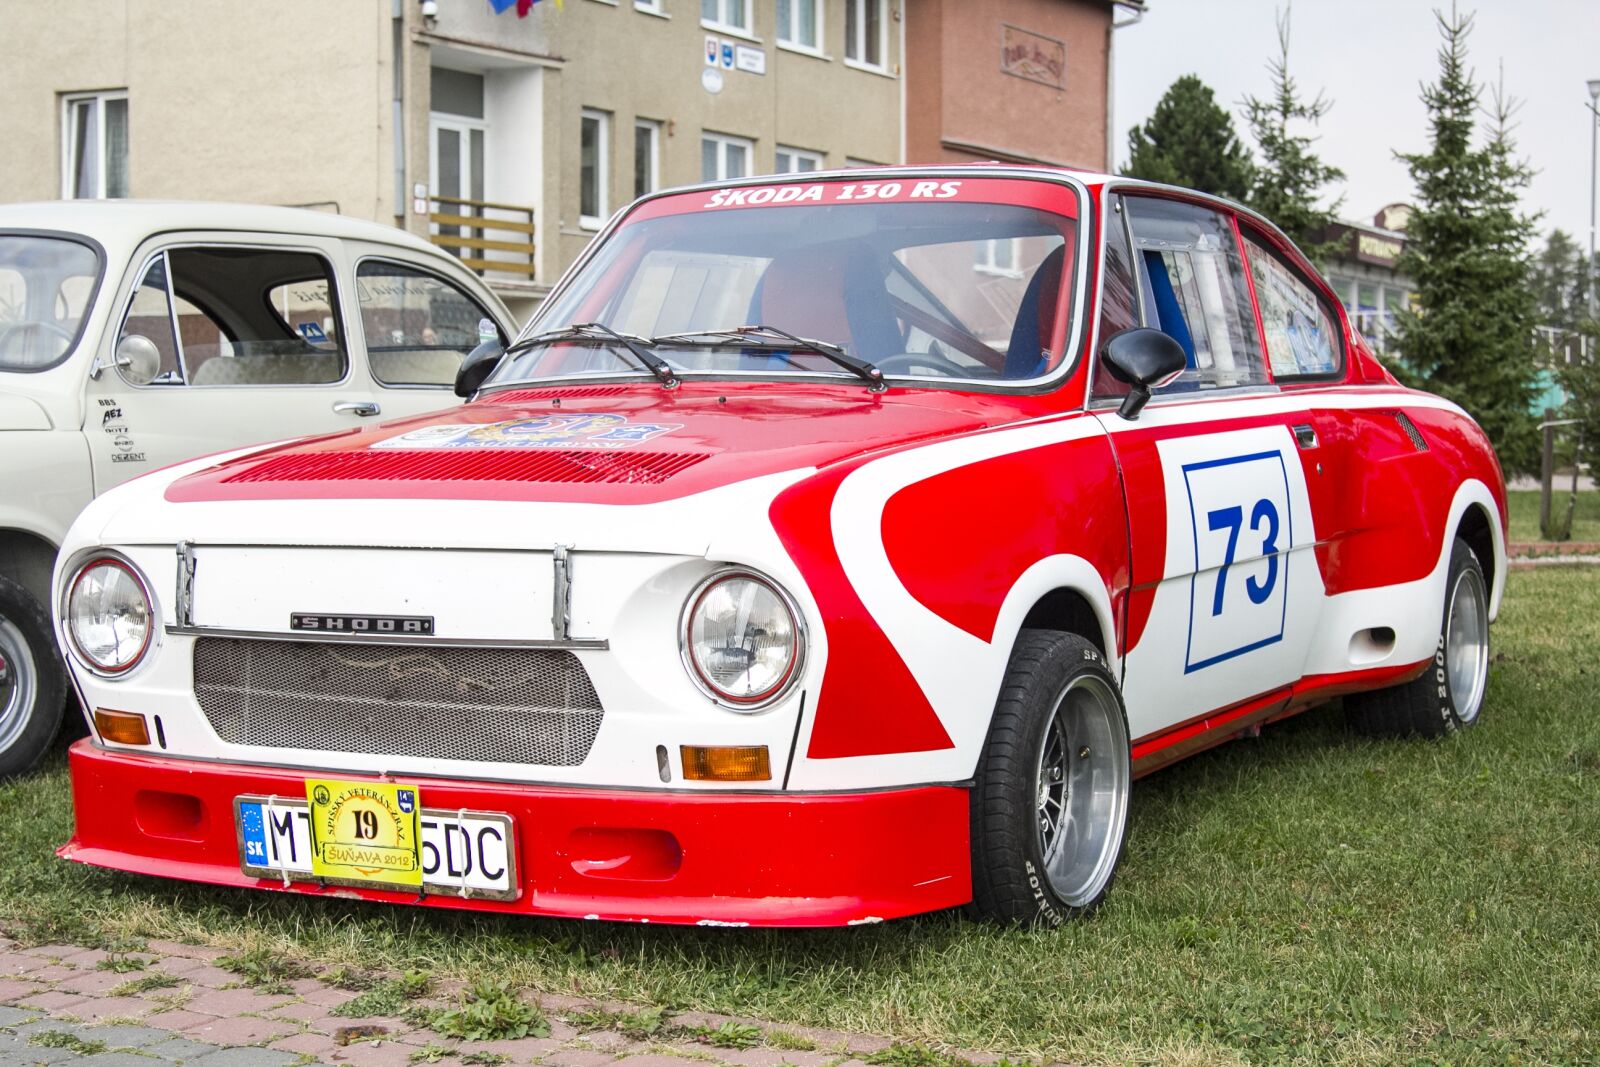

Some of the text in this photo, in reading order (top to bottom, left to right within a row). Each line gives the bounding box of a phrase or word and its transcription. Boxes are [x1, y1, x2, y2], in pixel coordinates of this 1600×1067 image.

[704, 181, 962, 208] ŠKODA 130 RS
[103, 408, 122, 425] AEZ
[1207, 498, 1280, 617] 73
[1083, 649, 1098, 661] SP
[327, 787, 406, 841] SPIŠSKÝ VETERÁN ZRAZ
[352, 809, 379, 840] 19
[247, 841, 264, 857] SK
[328, 846, 410, 866] ŠUŇAVA 2012
[420, 821, 506, 881] 5DC
[1025, 860, 1062, 926] DUNLOP
